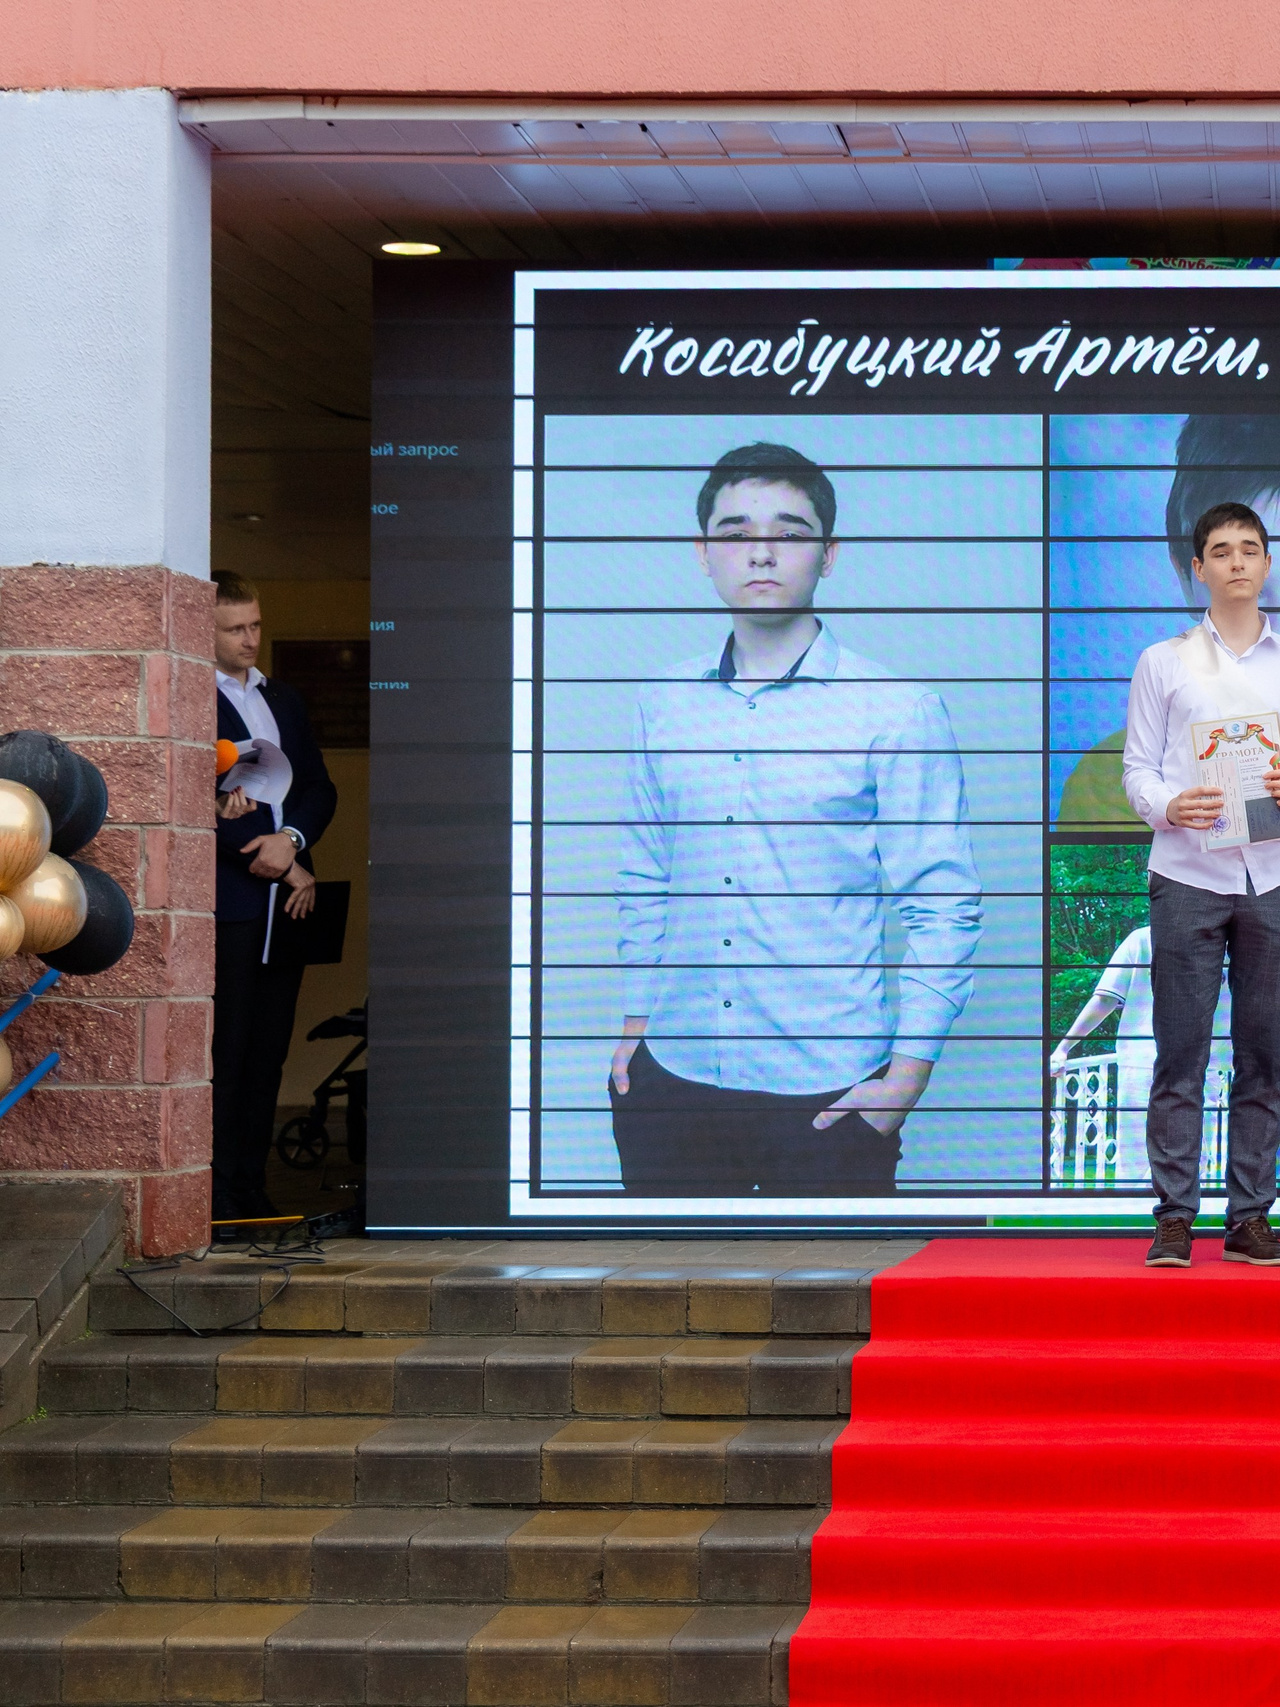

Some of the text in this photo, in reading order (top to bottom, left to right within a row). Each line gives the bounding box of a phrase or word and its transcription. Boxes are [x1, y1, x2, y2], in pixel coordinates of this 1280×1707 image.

[619, 318, 1001, 396] Косабуцкий
[1014, 320, 1269, 392] Артём,
[398, 444, 459, 460] запрос
